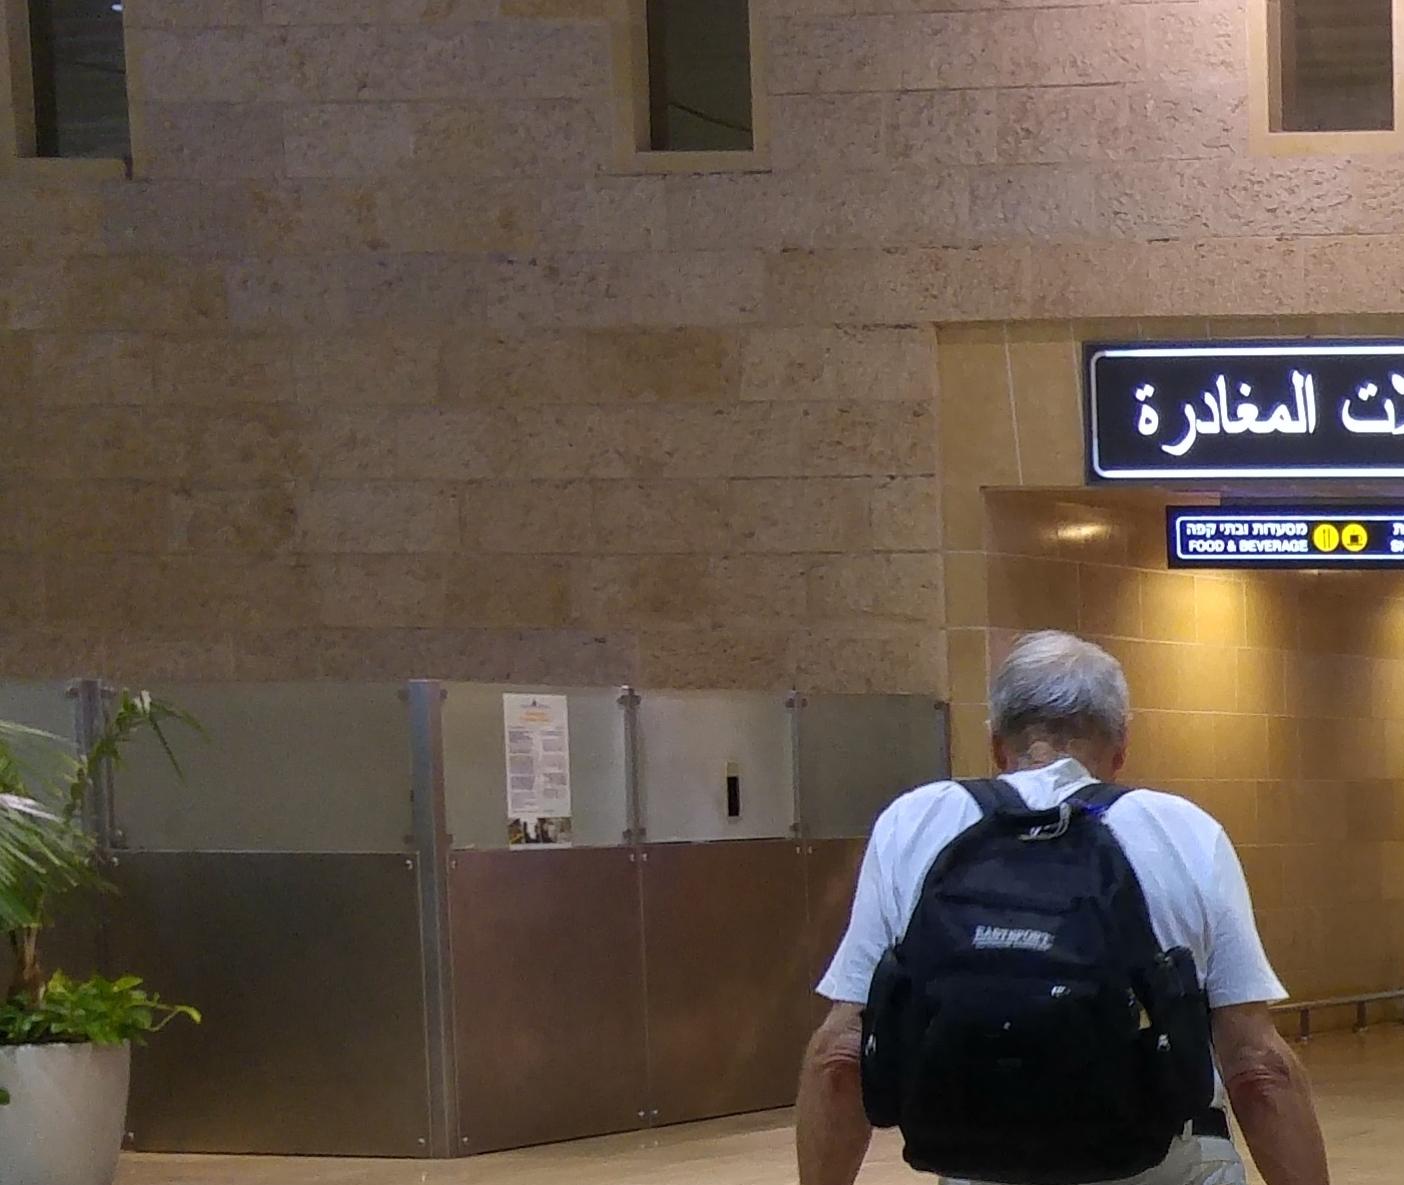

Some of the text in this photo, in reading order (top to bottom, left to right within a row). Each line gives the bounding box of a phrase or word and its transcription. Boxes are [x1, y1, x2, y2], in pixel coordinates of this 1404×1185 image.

[1135, 369, 1318, 457] المغادرة
[1186, 523, 1216, 537] קפה
[1188, 540, 1309, 553] FOOD & BEVERAGE
